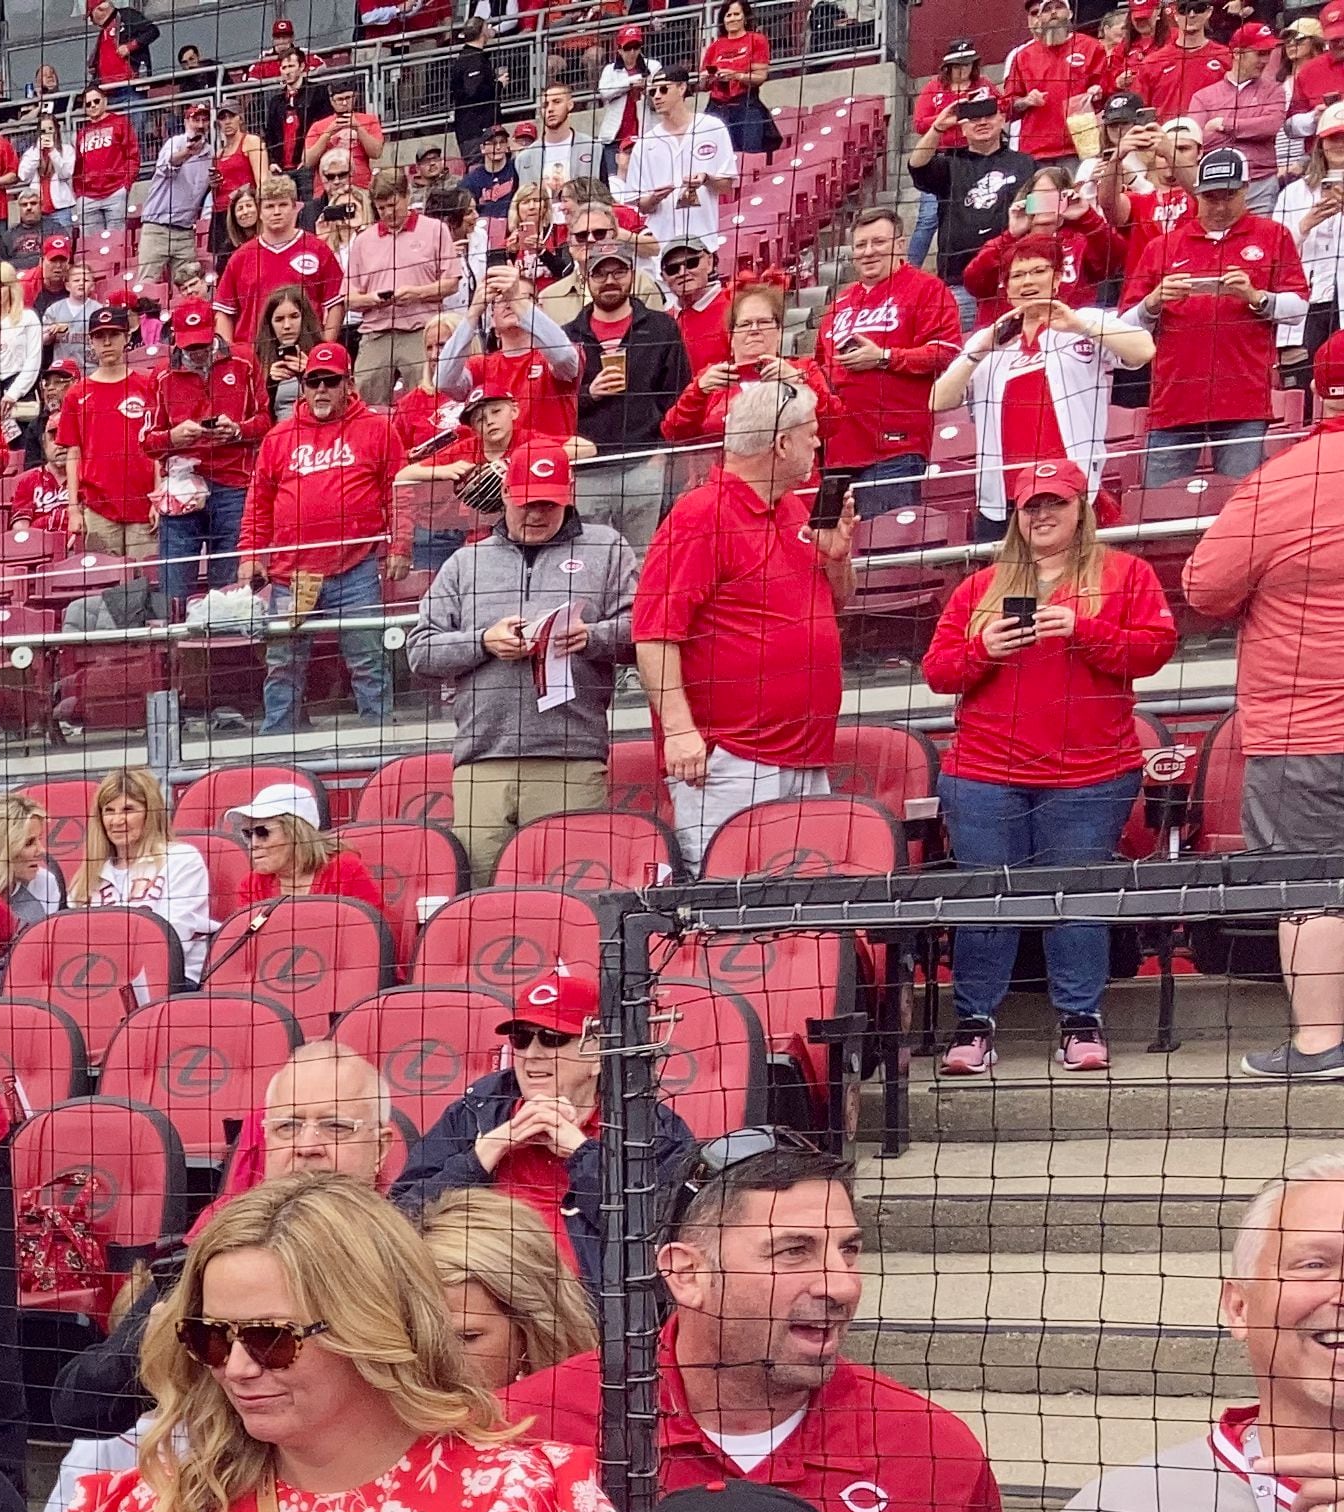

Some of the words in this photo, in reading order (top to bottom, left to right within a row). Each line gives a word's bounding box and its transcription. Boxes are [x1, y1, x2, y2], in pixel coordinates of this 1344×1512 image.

[289, 438, 356, 475] Reds
[1155, 759, 1187, 774] REDS
[528, 984, 559, 1005] C
